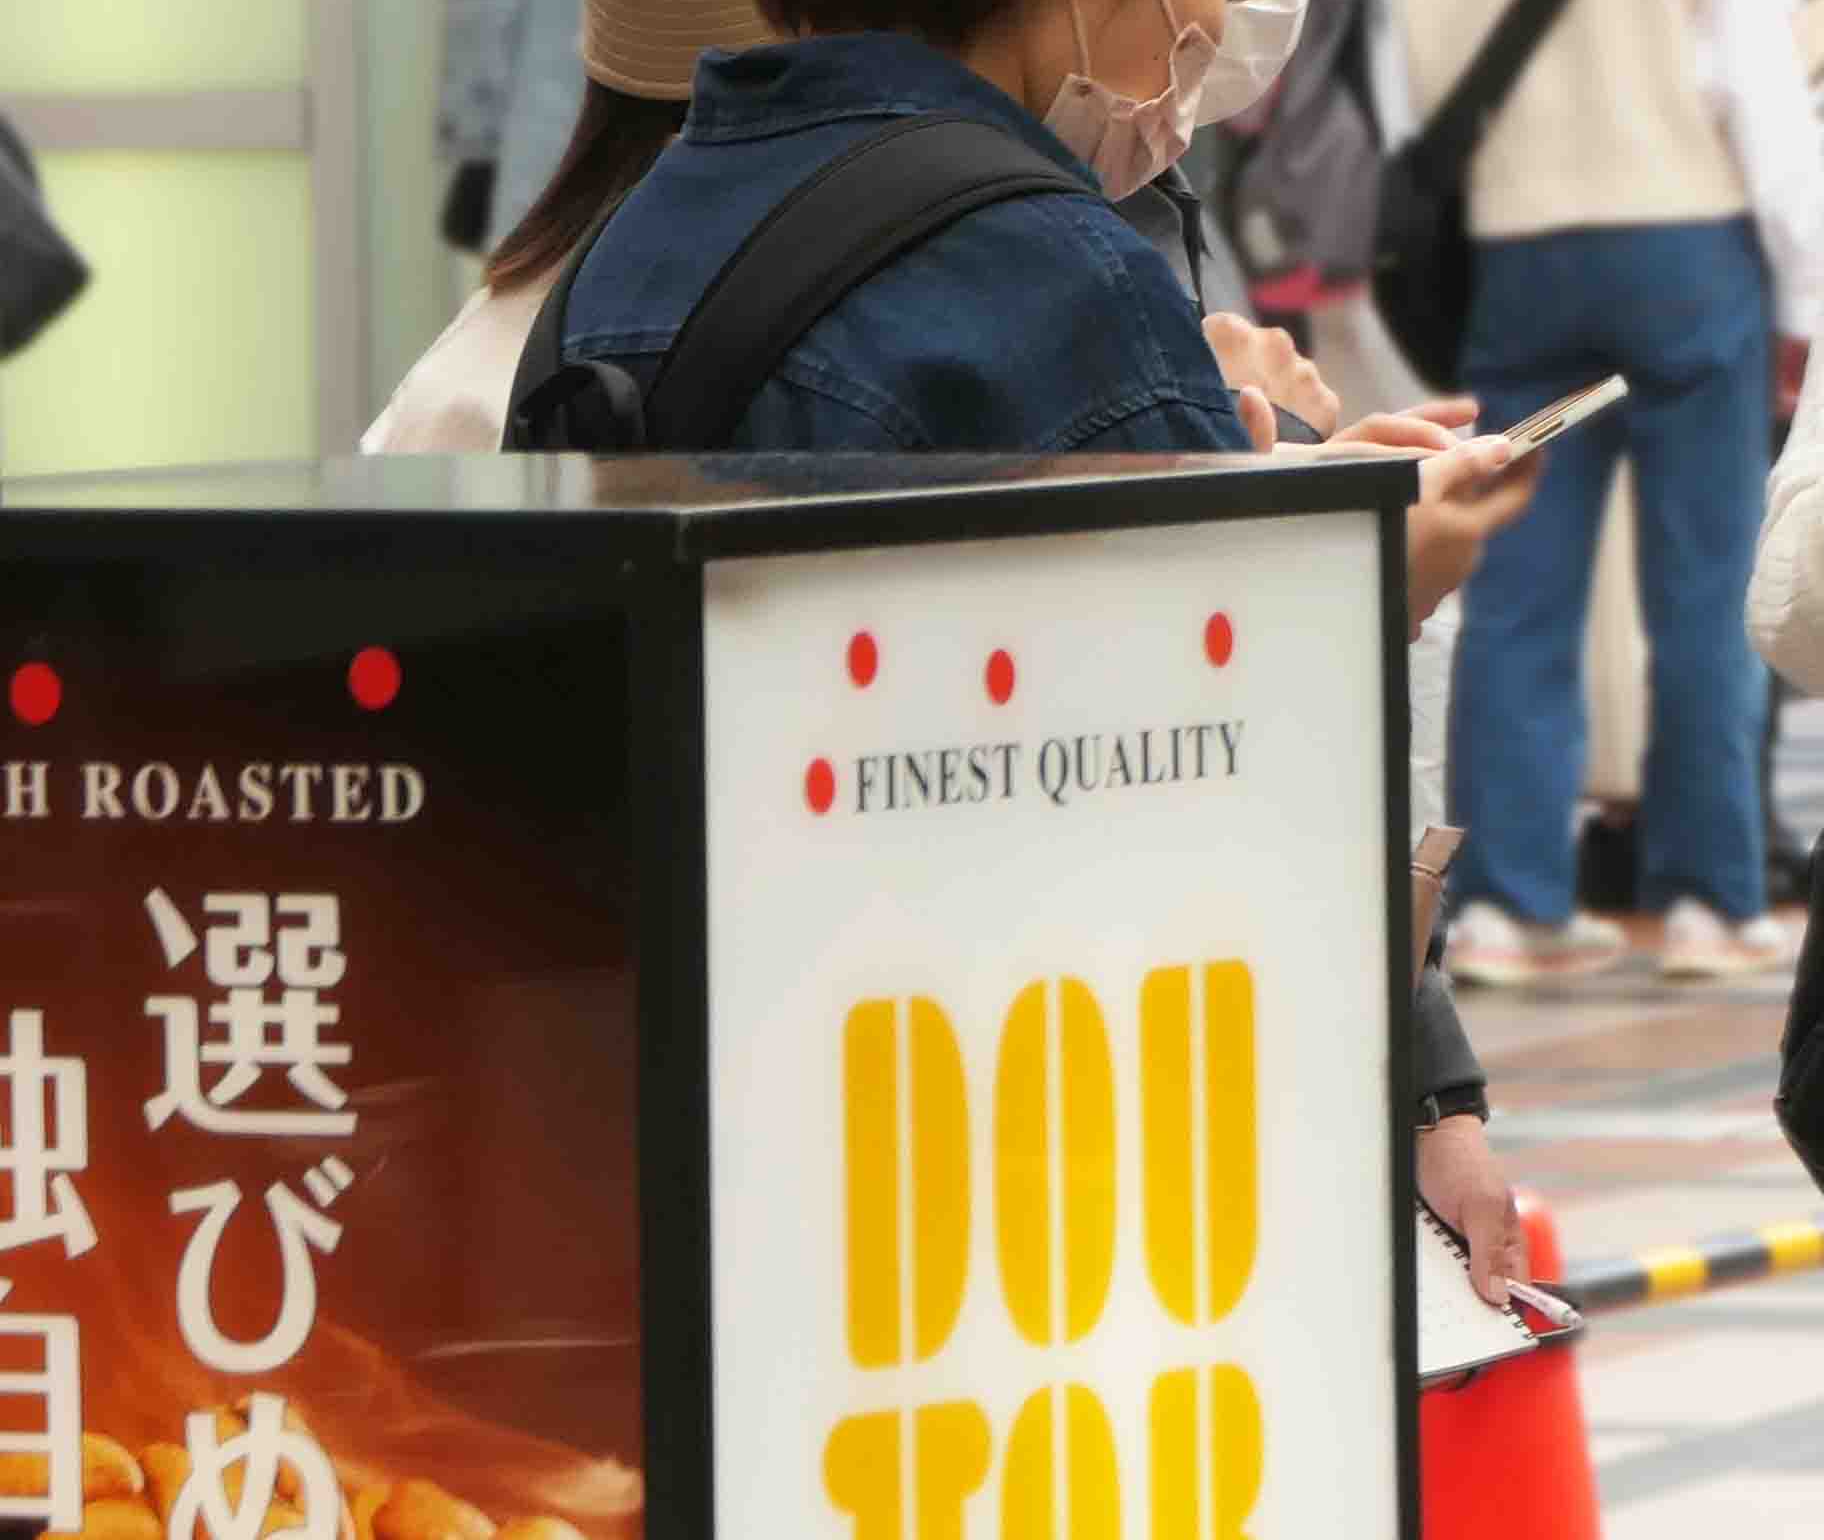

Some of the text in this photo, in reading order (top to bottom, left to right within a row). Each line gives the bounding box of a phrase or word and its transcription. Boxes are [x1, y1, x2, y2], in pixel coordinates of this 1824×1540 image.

[82, 762, 425, 823] ROASTED
[854, 719, 1246, 813] FINEST QUALITY
[840, 958, 1262, 1372] DOU
